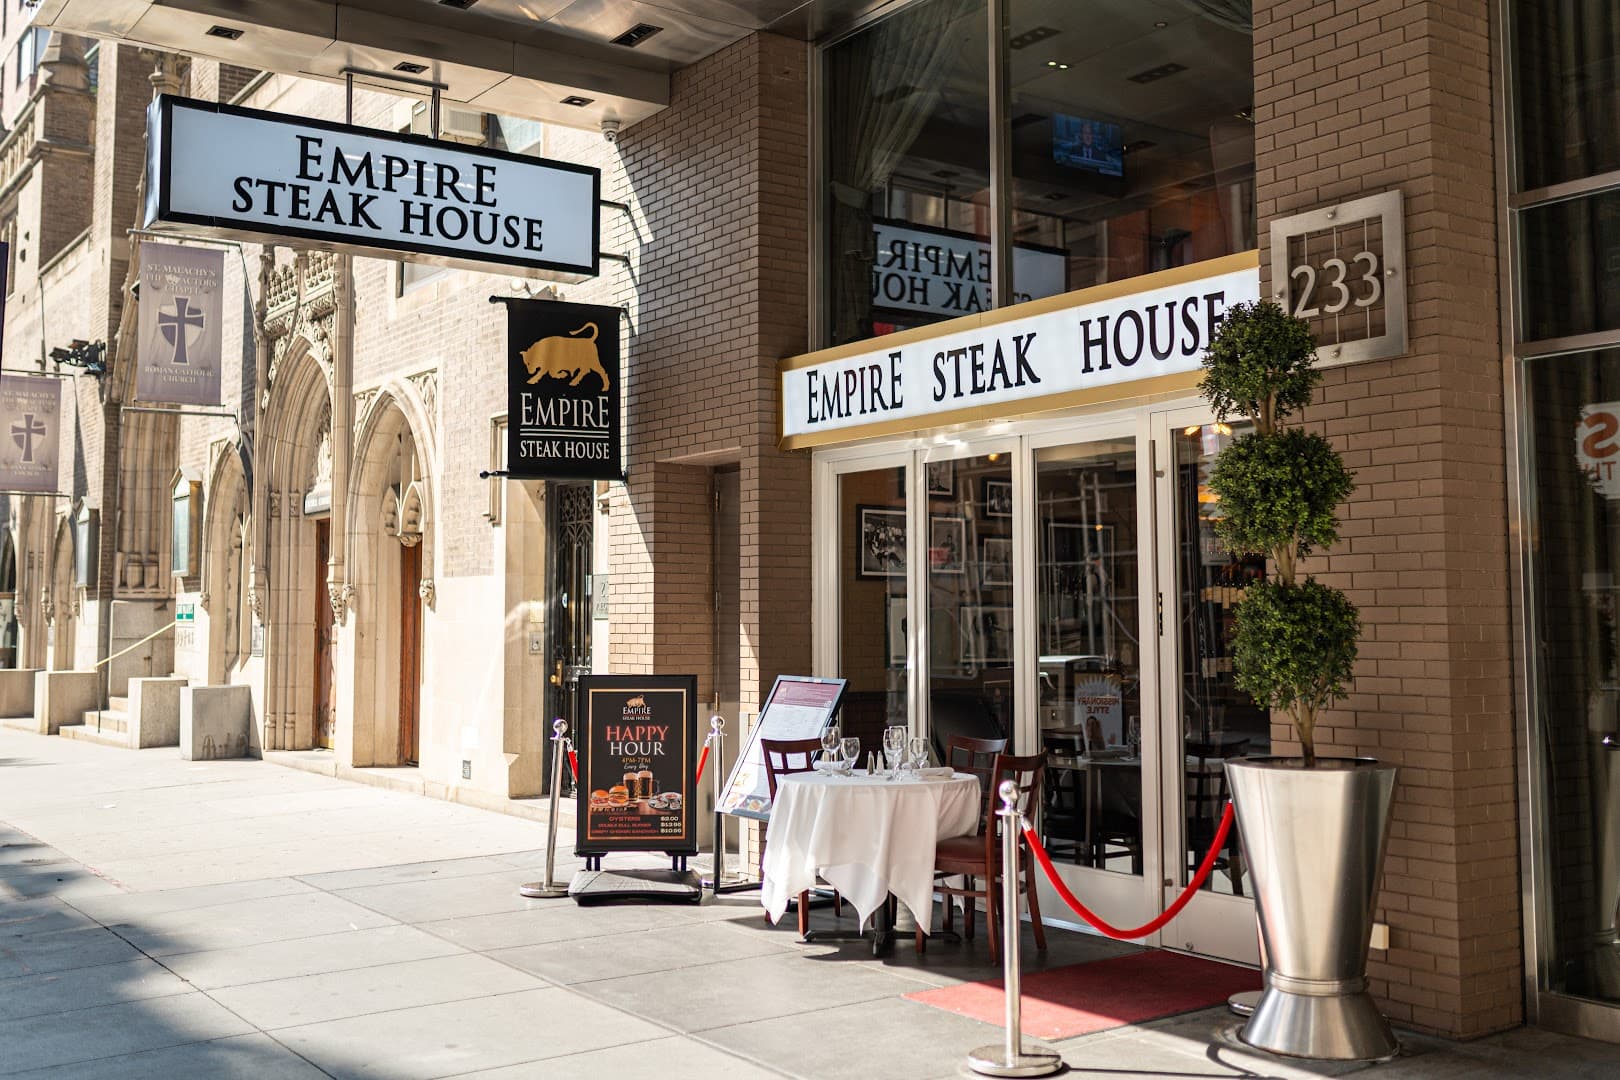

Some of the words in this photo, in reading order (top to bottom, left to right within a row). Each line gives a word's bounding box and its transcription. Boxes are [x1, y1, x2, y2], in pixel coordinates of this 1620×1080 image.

[296, 135, 497, 208] EMPIRE
[232, 176, 382, 230] STEAK
[399, 199, 543, 252] HOUSE
[1290, 251, 1381, 319] 233
[807, 350, 903, 424] EMPIRE
[932, 332, 1041, 402] STEAK
[1080, 291, 1225, 374] HOUSE
[520, 392, 610, 428] EMPIRE
[520, 440, 562, 458] STEAK
[564, 441, 610, 459] HOUSE
[622, 706, 652, 715] EMPIRE
[606, 725, 669, 741] HAPPY
[610, 741, 665, 756] HOUR
